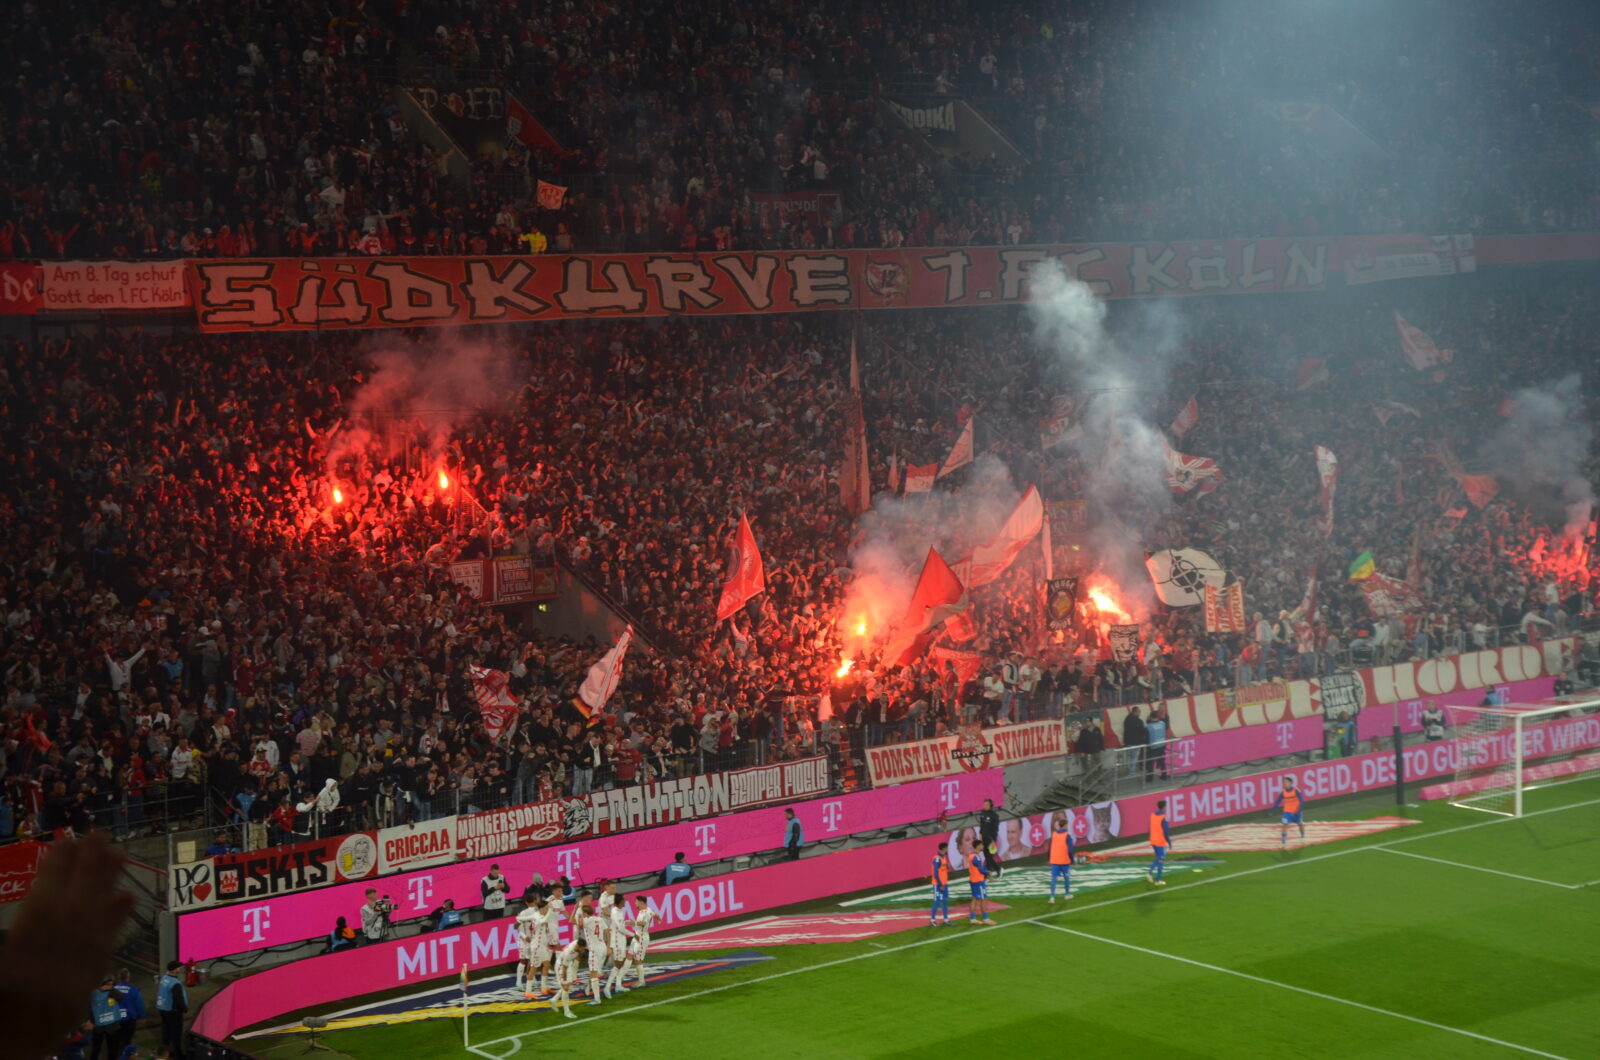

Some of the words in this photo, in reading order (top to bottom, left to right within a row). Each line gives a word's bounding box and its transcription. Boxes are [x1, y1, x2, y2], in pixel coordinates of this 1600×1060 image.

[889, 100, 957, 132] ROIKA
[53, 266, 80, 281] Am
[86, 266, 99, 281] 8.
[103, 266, 129, 285] Tag
[135, 266, 176, 281] schuf
[198, 254, 851, 328] SÜDKURVE
[1129, 243, 1327, 295] KÖLN
[47, 288, 82, 303] Gott
[86, 288, 114, 304] den
[152, 286, 182, 303] Köln
[1371, 638, 1577, 705] HORDE
[870, 741, 952, 781] DOMSTADT
[993, 723, 1063, 762] SYNDIKAT
[1190, 781, 1256, 818] MEHR
[1303, 764, 1358, 797] SEID,
[1361, 743, 1429, 786] DESTO
[1433, 728, 1545, 770] GÜNSTIGER
[1548, 717, 1600, 752] WIRD
[591, 771, 730, 835] FRAKTION
[730, 766, 782, 807] SEMPER
[784, 758, 829, 796] FIDELIS
[385, 828, 451, 862] CRICCAA
[457, 802, 560, 842] MÜNGERSDORFER
[465, 831, 519, 859] STADION
[174, 863, 211, 889] DO
[396, 936, 448, 981] MIT
[469, 900, 635, 964] MAEA
[646, 879, 744, 929] MOBIL
